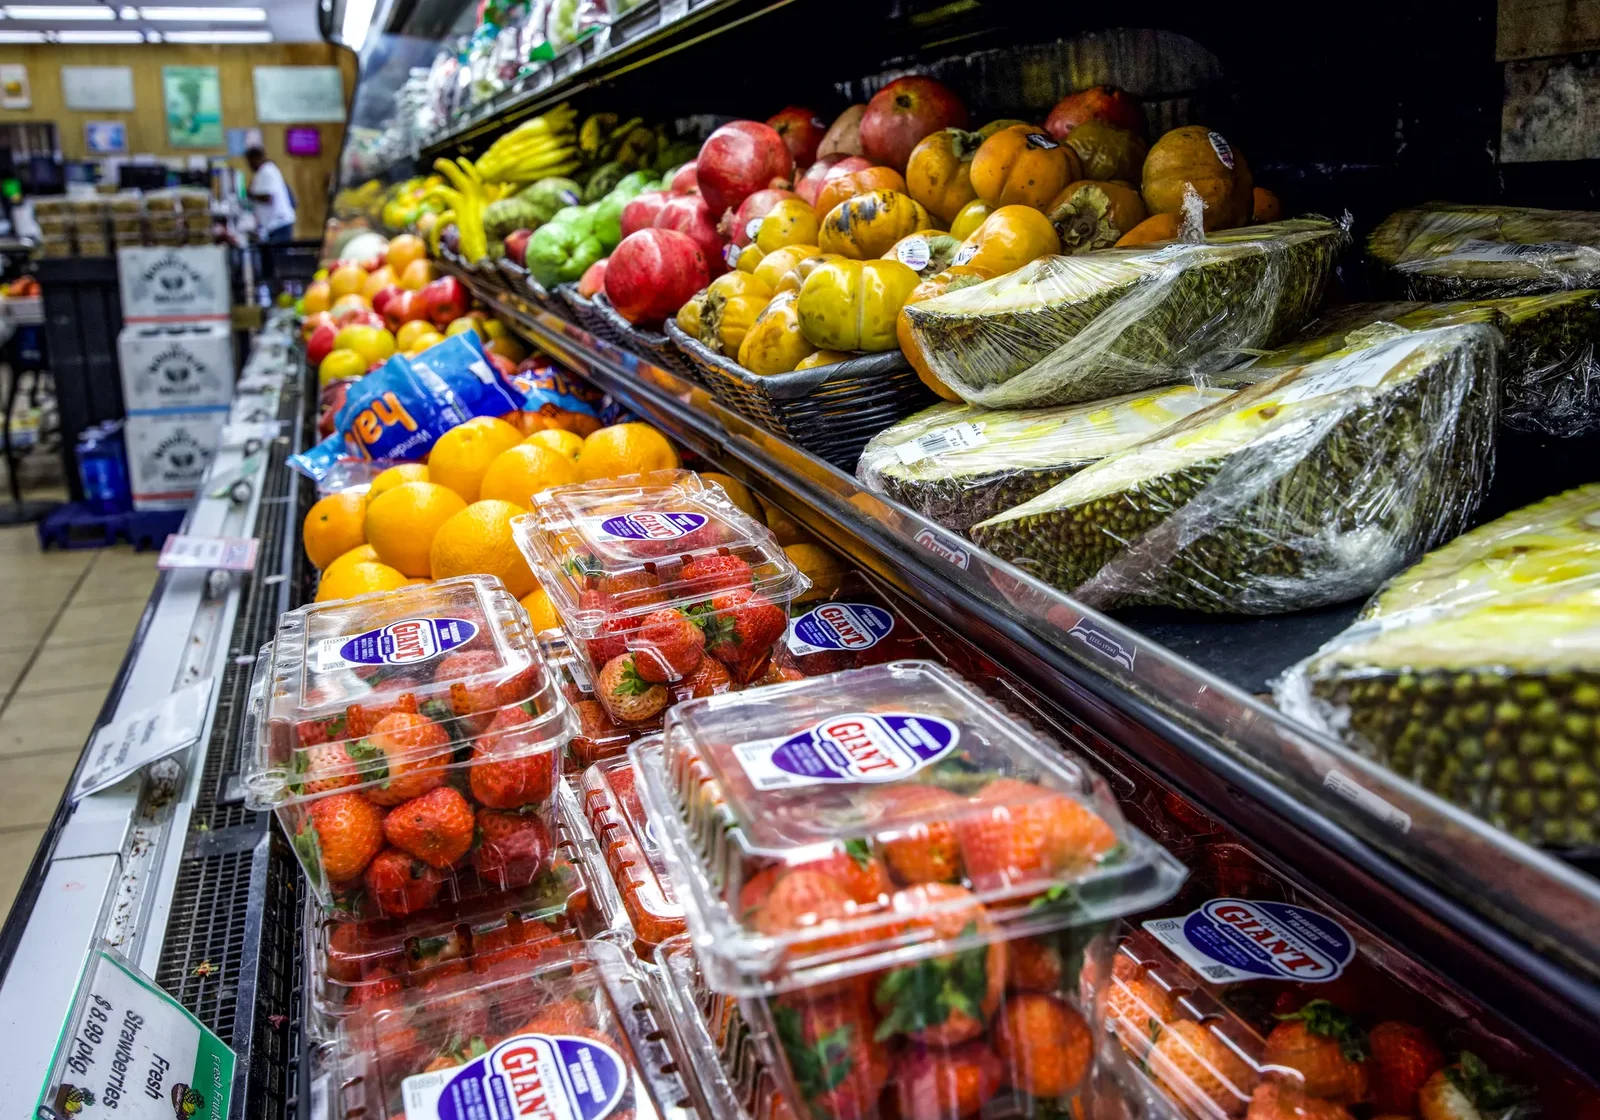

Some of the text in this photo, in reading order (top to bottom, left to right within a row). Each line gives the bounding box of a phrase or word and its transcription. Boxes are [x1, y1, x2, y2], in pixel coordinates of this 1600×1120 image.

[633, 514, 676, 537] GIANT
[392, 622, 425, 660] GIANT
[820, 607, 868, 645] GIANT
[827, 722, 898, 773] GIANT
[1214, 905, 1324, 972] GIANT
[1224, 925, 1244, 944] BERRY
[1259, 918, 1307, 951] CALIFORNIA
[1285, 909, 1344, 948] STRAWBERRIES
[1287, 919, 1321, 942] FRAISES
[67, 1037, 96, 1076] pkg.
[102, 1010, 144, 1110] Strawberries
[211, 1053, 223, 1089] Fresh
[144, 1052, 171, 1100] Fresh
